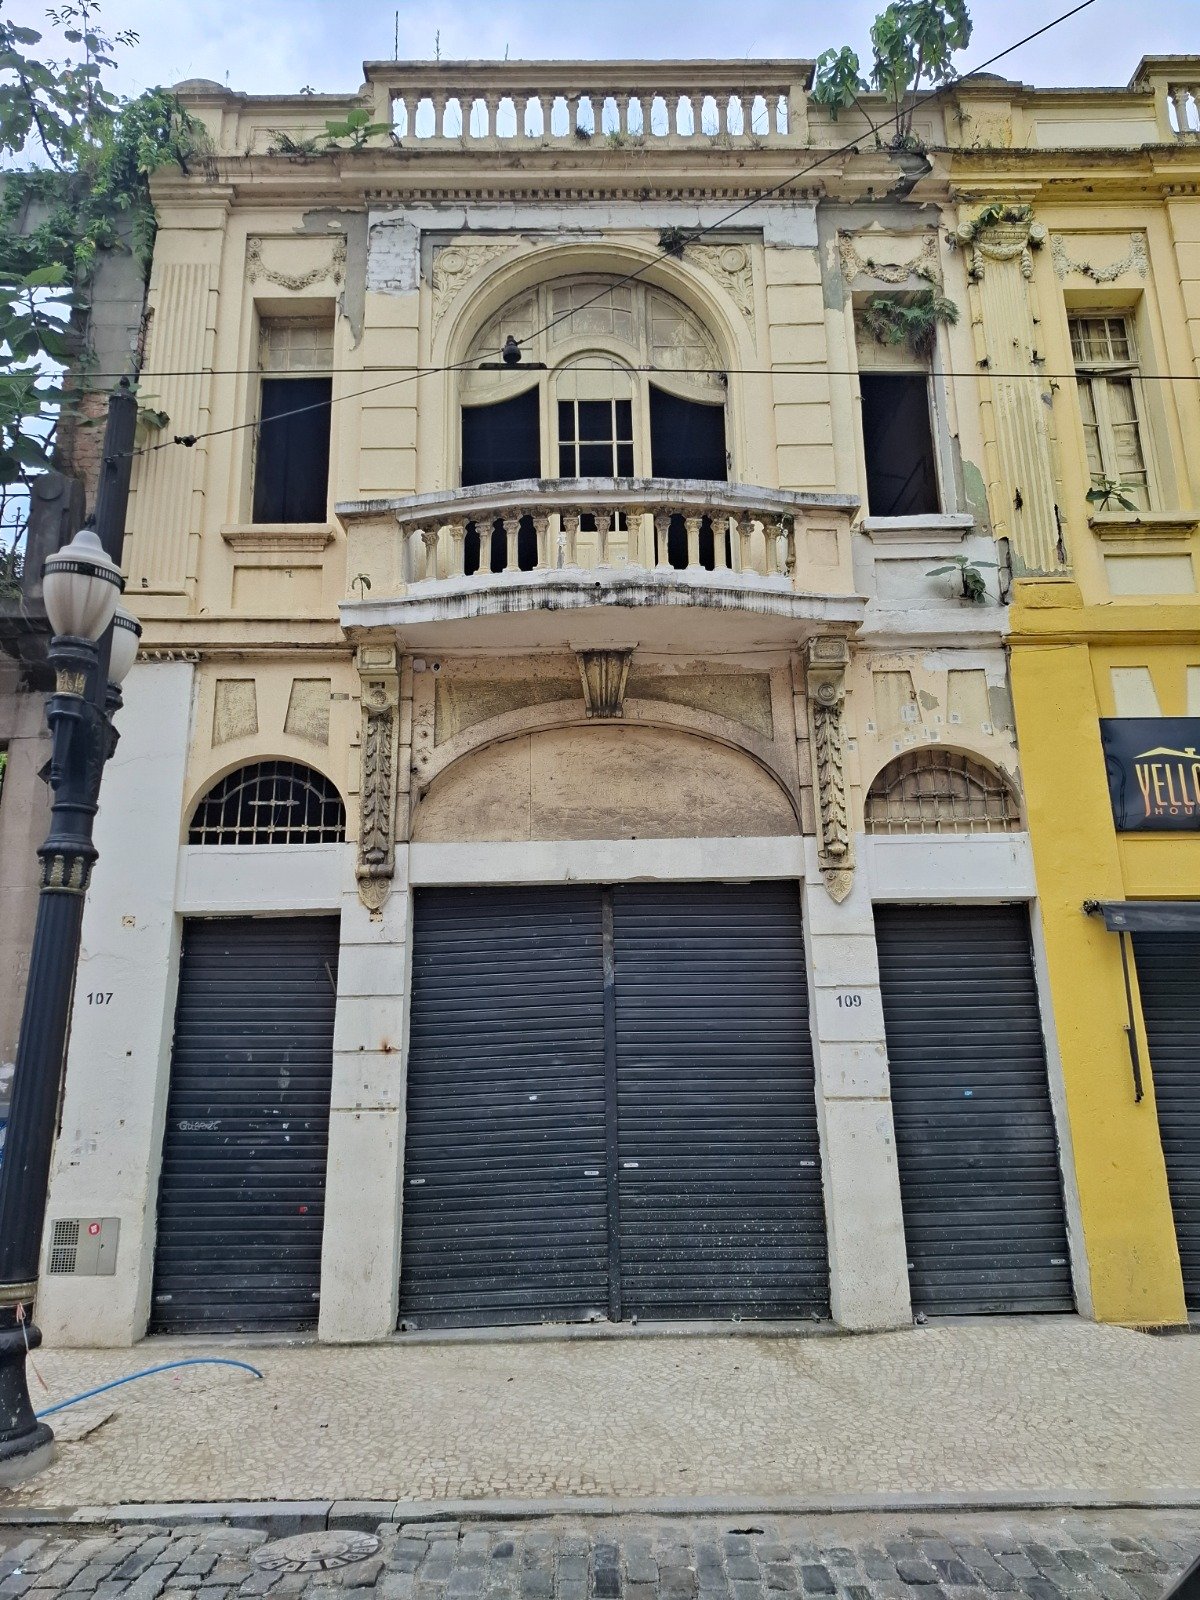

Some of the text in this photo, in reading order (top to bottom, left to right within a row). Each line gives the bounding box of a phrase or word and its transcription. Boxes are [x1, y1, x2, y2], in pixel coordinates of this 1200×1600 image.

[1154, 806, 1200, 815] HOU
[86, 992, 114, 1006] 107
[835, 994, 862, 1008] 109
